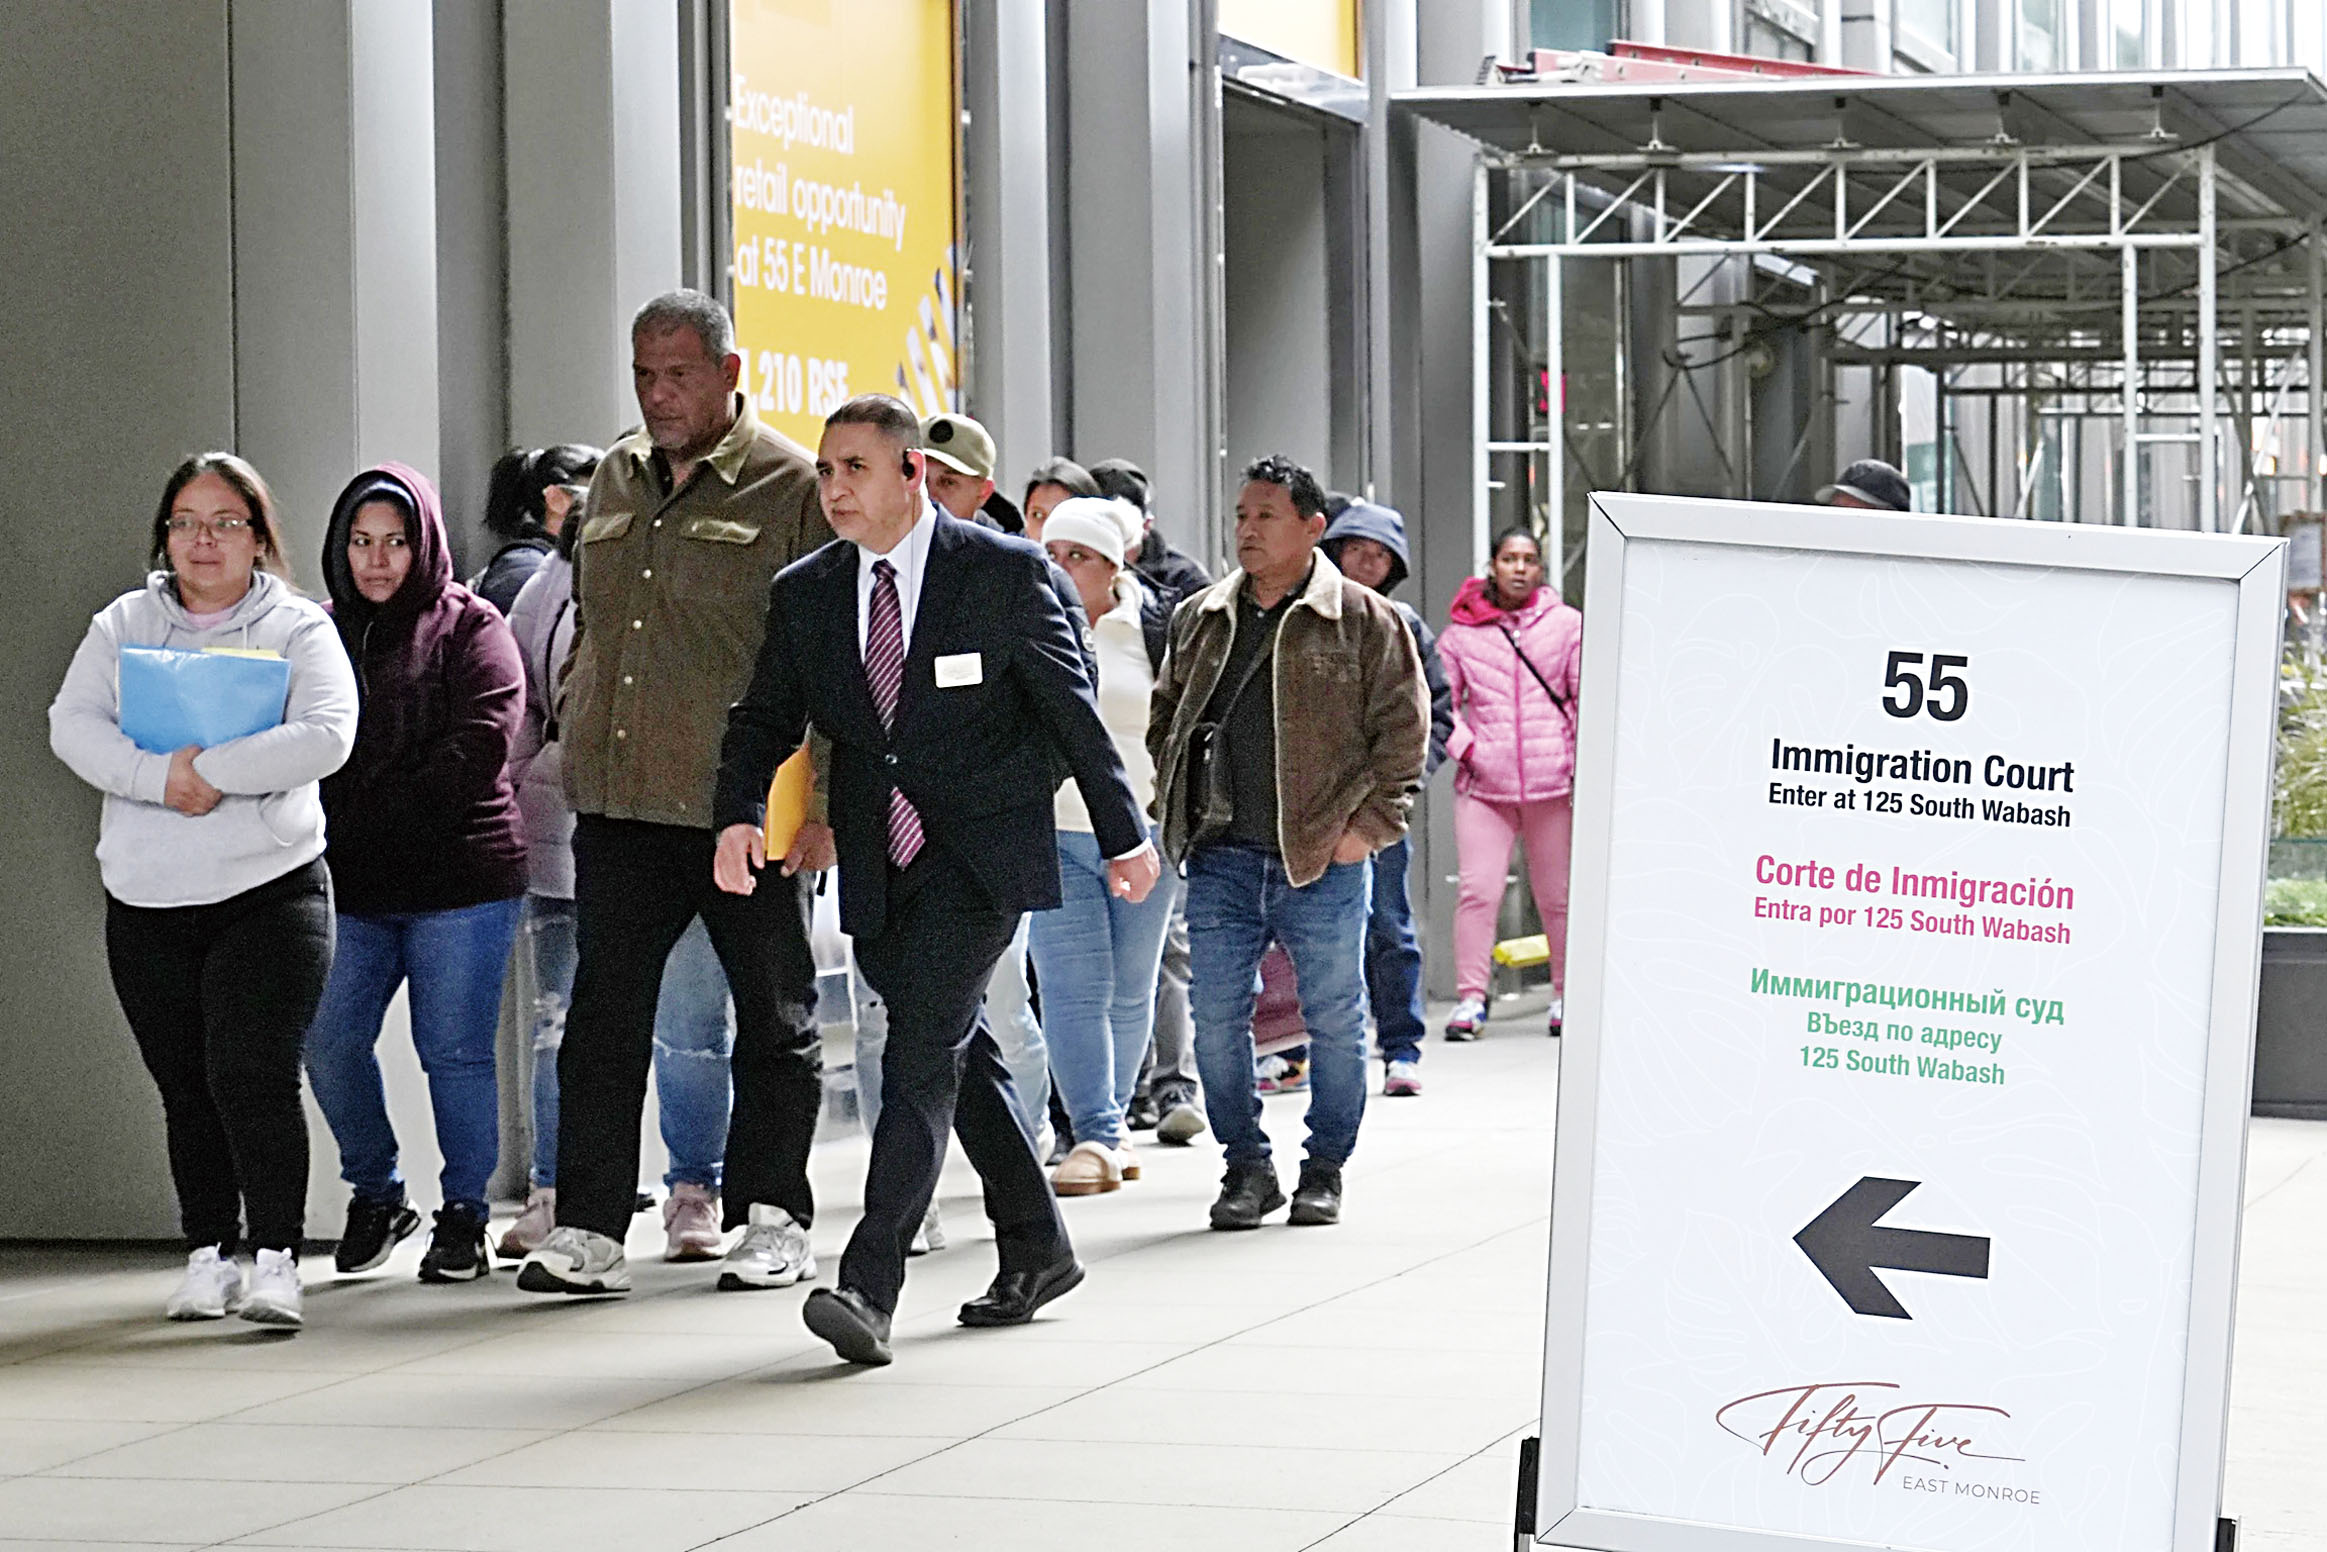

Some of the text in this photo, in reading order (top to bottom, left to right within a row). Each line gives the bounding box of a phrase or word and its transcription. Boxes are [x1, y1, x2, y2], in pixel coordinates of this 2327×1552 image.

[735, 74, 854, 155] Exceptional
[735, 158, 906, 252] retail opportunity
[737, 234, 888, 311] at 55 E Monroe
[1881, 650, 1969, 722] 55
[1771, 737, 2075, 793] Immigration Court
[1768, 781, 2071, 828] Enter at 125 South Wabash
[1756, 854, 2074, 910] Corte de Inmigración
[1754, 896, 2071, 945] Entra por 125 South Wabash
[1751, 967, 2065, 1026] Иммиграционный суд
[1800, 1045, 2005, 1085] 125 South Wabash
[1886, 1023, 1913, 1042] по
[1920, 1026, 2003, 1055] адресу
[1716, 1381, 2026, 1486] Fifty Five
[1903, 1475, 2041, 1505] EAST MONROE
